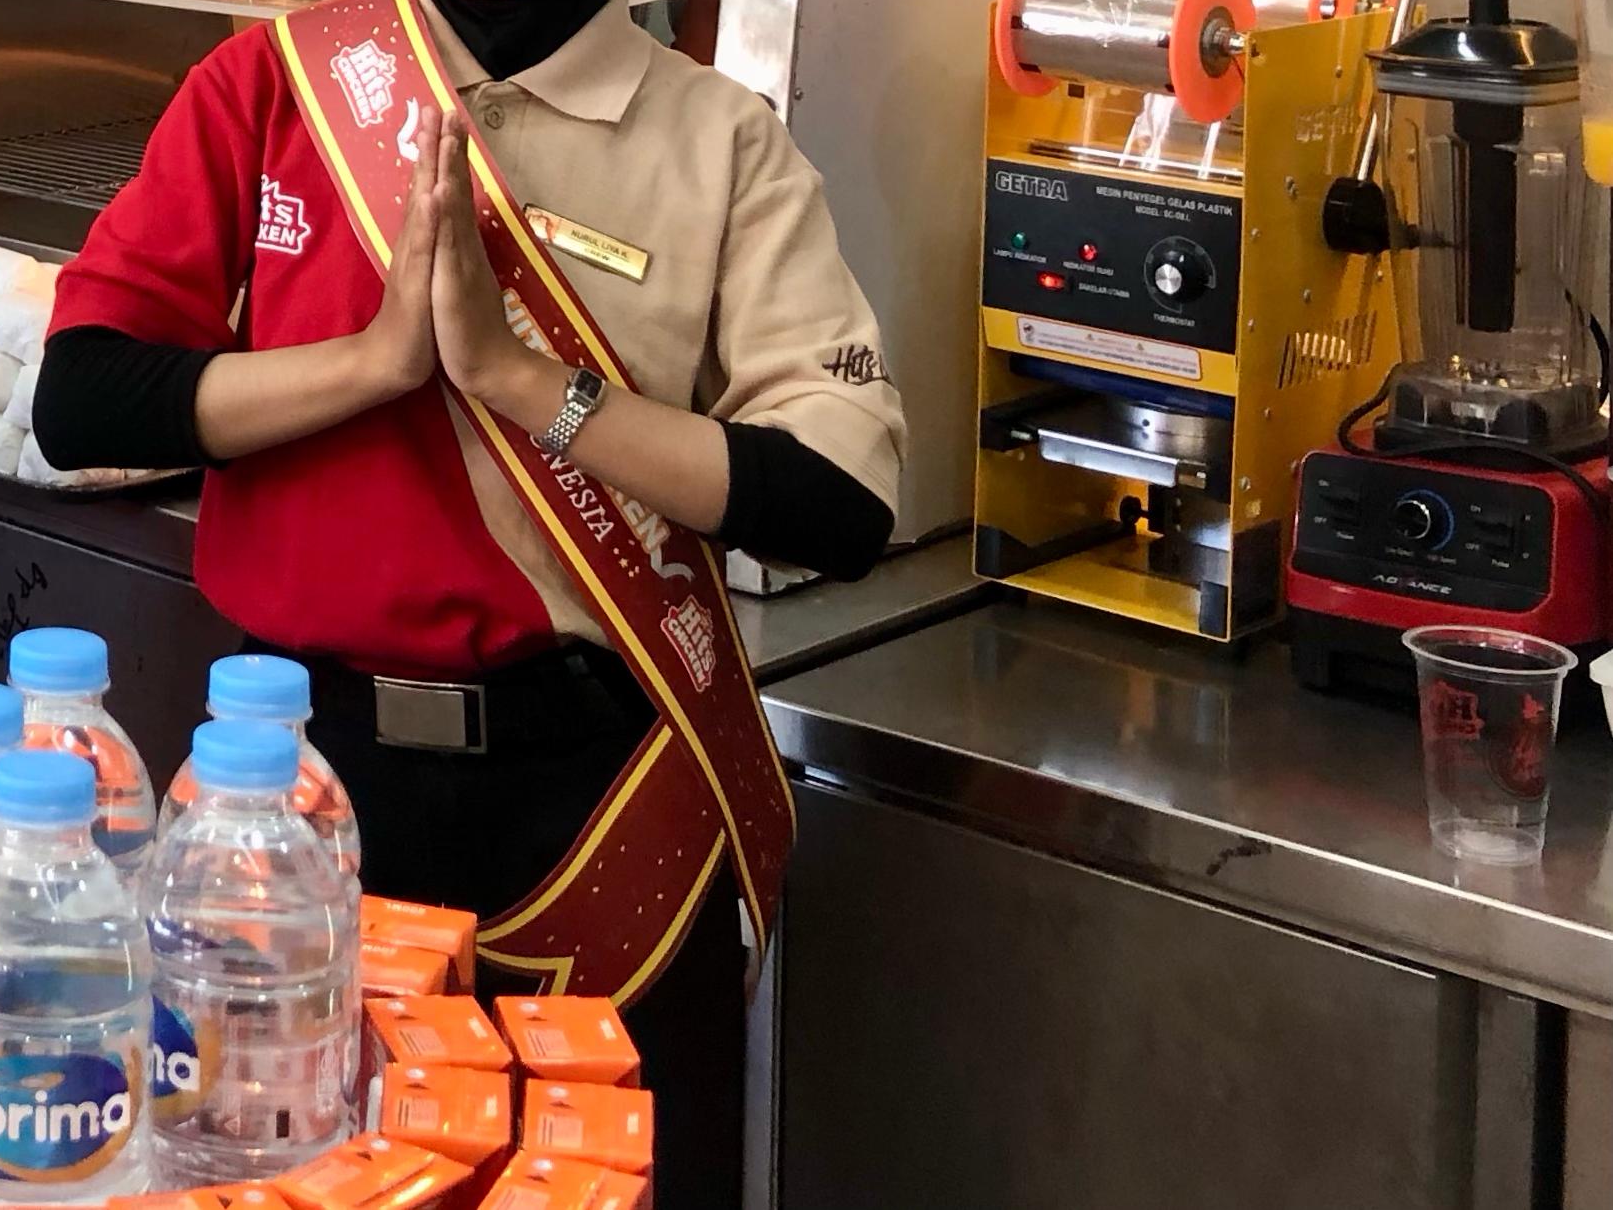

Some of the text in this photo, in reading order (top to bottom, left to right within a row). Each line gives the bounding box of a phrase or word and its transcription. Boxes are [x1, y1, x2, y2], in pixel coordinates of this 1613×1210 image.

[995, 171, 1068, 201] GETRA
[1167, 197, 1195, 210] GELAS
[1197, 201, 1233, 217] PLASTIK
[668, 618, 706, 684] CHICKEN
